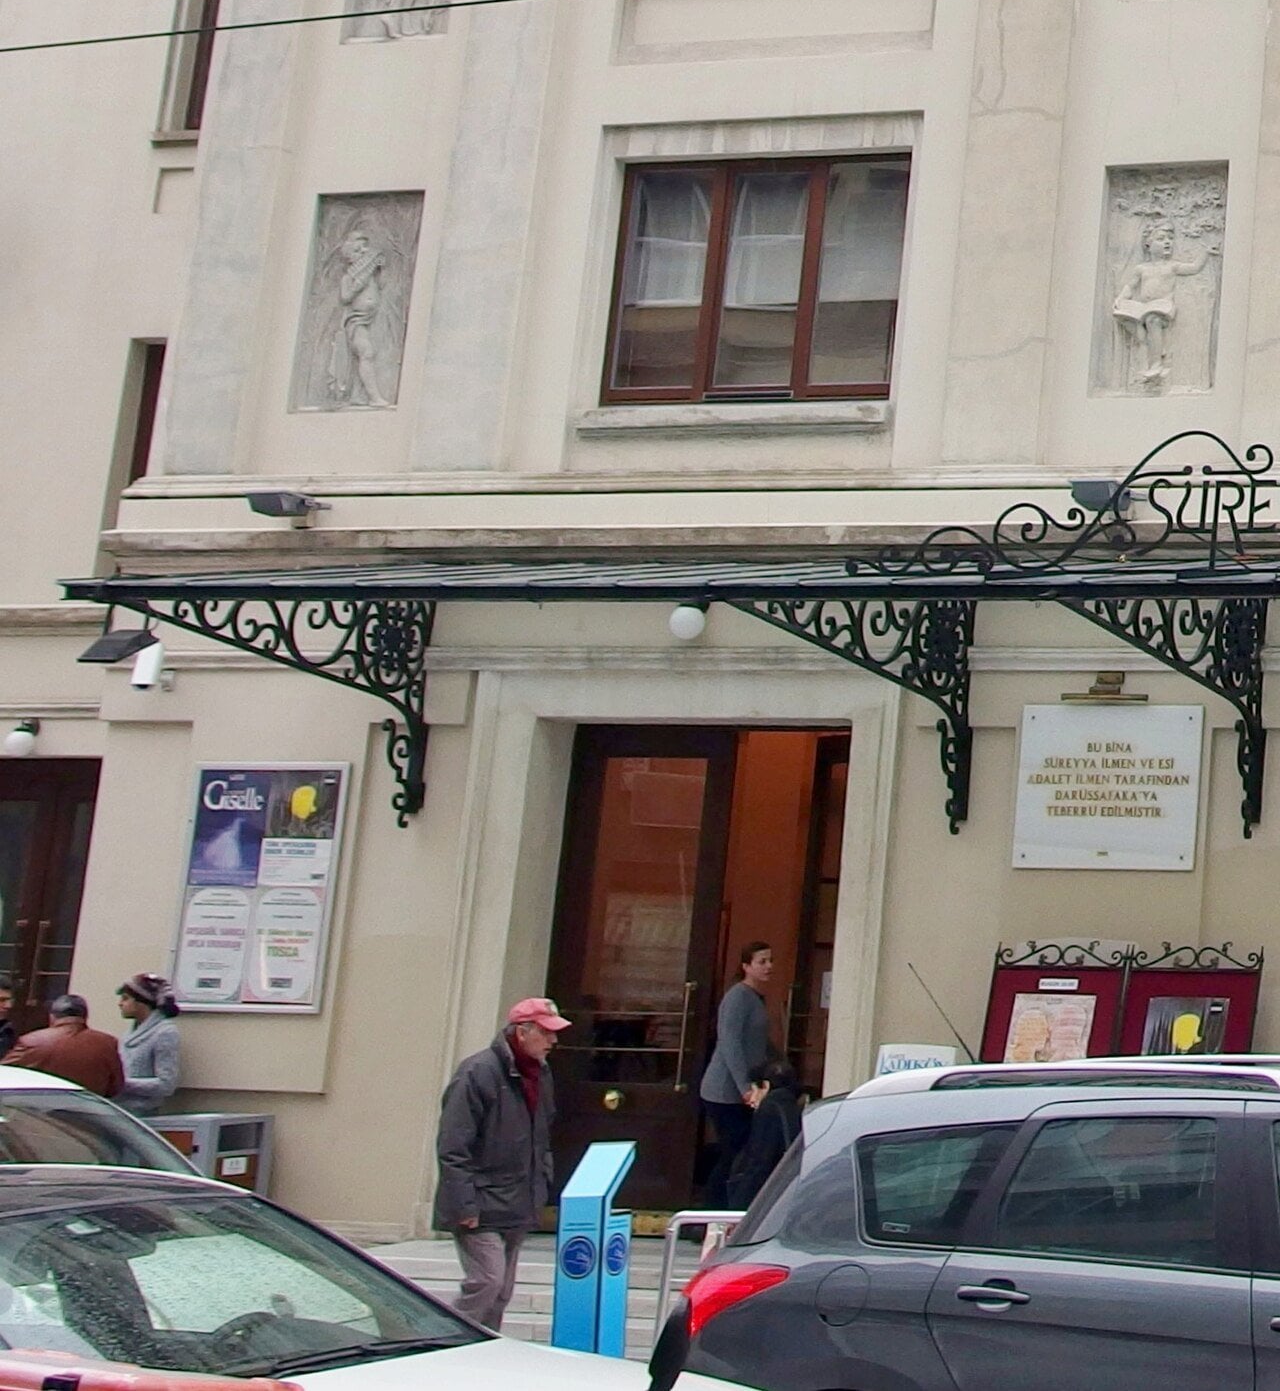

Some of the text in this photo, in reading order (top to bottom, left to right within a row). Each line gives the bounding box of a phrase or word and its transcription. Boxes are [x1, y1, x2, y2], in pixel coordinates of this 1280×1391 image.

[1087, 741, 1132, 753] BU BİNA
[1043, 757, 1097, 769] SÜREYYA
[1101, 757, 1136, 770] İLMEN
[1140, 758, 1154, 769] VE
[1027, 774, 1072, 785] ADALET
[1115, 774, 1190, 786] TARAFINDAN
[203, 779, 265, 811] Giselle
